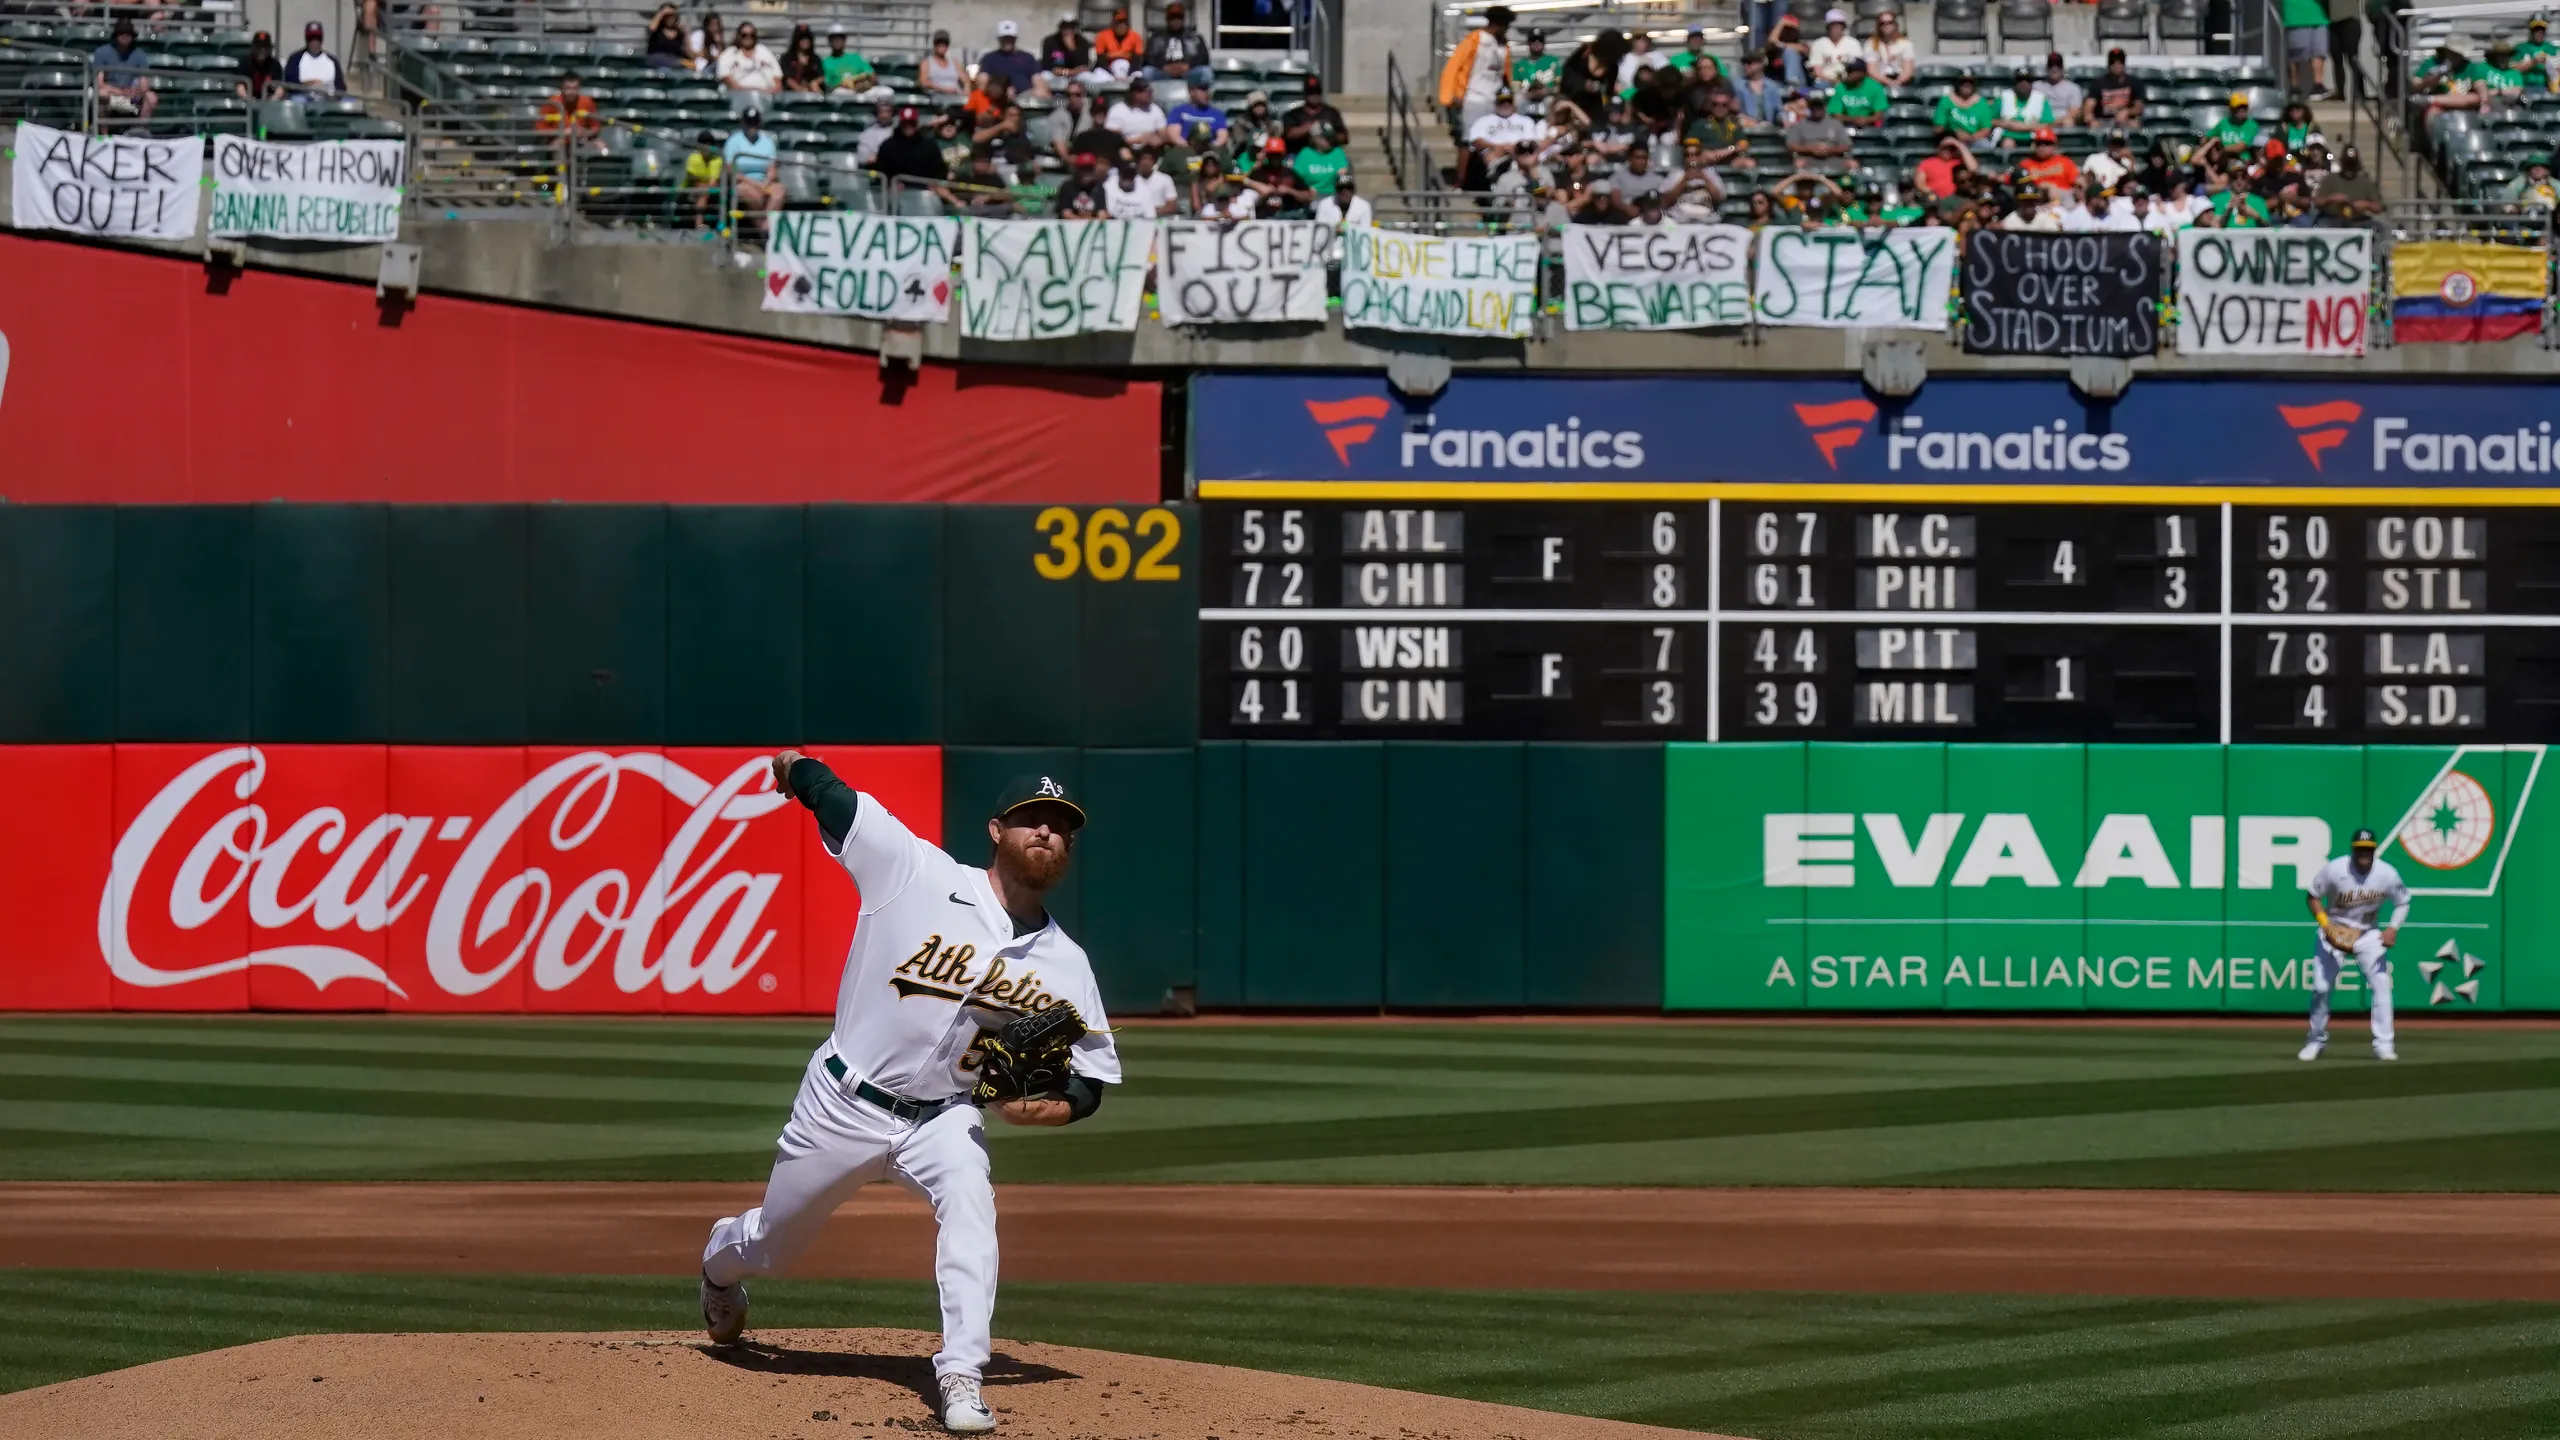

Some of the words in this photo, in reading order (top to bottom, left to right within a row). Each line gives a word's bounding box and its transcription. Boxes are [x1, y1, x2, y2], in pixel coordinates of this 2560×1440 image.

[39, 136, 177, 183] AKER
[53, 181, 164, 231] OUT!
[213, 191, 289, 233] BANANA
[297, 195, 396, 236] REPUBLIC
[773, 211, 949, 264] NEVADA
[976, 221, 1143, 282] KAVAL
[1167, 223, 1333, 276] FISHER
[1341, 229, 1371, 272] NO
[1372, 236, 1447, 279] LOVE
[1453, 240, 1536, 284] LIKE
[1585, 234, 1736, 273] VEGAS
[1969, 230, 2150, 287] SCHOOLS
[1761, 231, 1946, 321] STAY
[2194, 236, 2364, 286] OWNERS
[817, 268, 897, 312] FOLD
[961, 275, 1122, 338] WEASEL
[1182, 273, 1301, 319] OUT
[1342, 278, 1464, 328] OAKLAND
[1467, 287, 1534, 336] LOVE
[1571, 281, 1747, 328] BEWARE
[2018, 273, 2100, 307] OVER
[1968, 290, 2155, 353] STADIUMS
[2185, 293, 2301, 347] VOTE
[2306, 292, 2366, 355] NO!
[1402, 414, 1645, 468] Fanatics
[1888, 416, 2130, 471] Fanatics
[1034, 507, 1181, 581] 362
[1243, 510, 1304, 554] 55
[1360, 510, 1447, 552] ATL
[1652, 511, 1676, 555] 6
[1756, 512, 1817, 556] 67
[1872, 513, 1961, 557] K.C.
[2166, 515, 2186, 557] 1
[2268, 515, 2329, 560] 50
[2378, 517, 2475, 560] COL
[1543, 537, 1563, 581] F
[2053, 540, 2076, 584] 4
[1242, 562, 1304, 606] 72
[1360, 562, 1447, 606] CHI
[1652, 564, 1677, 608] 8
[1756, 564, 1816, 606] 61
[1876, 566, 1956, 609] PHI
[2164, 567, 2187, 609] 3
[2267, 568, 2328, 612] 32
[2382, 568, 2472, 610] STL
[1240, 627, 1304, 671] 60
[1355, 626, 1449, 668] WSH
[1653, 628, 1674, 671] 7
[1755, 629, 1818, 673] 44
[1879, 629, 1958, 669] PIT
[2267, 632, 2330, 676] 78
[2379, 633, 2469, 675] L.A.
[1542, 654, 1562, 698] F
[2056, 658, 2074, 700] 1
[1239, 680, 1301, 723] 41
[1360, 680, 1446, 720] CIN
[1651, 681, 1674, 724] 3
[1756, 682, 1818, 725] 39
[1868, 683, 1959, 723] MIL
[2303, 686, 2327, 727] 4
[2380, 685, 2471, 726] S.D.
[1036, 776, 1064, 798] A's
[98, 746, 791, 999] Coca-Cola
[896, 934, 1058, 1015] Athletic
[1765, 956, 1796, 988] A
[1811, 956, 1928, 988] STAR
[1944, 956, 2172, 989] ALLIANCE
